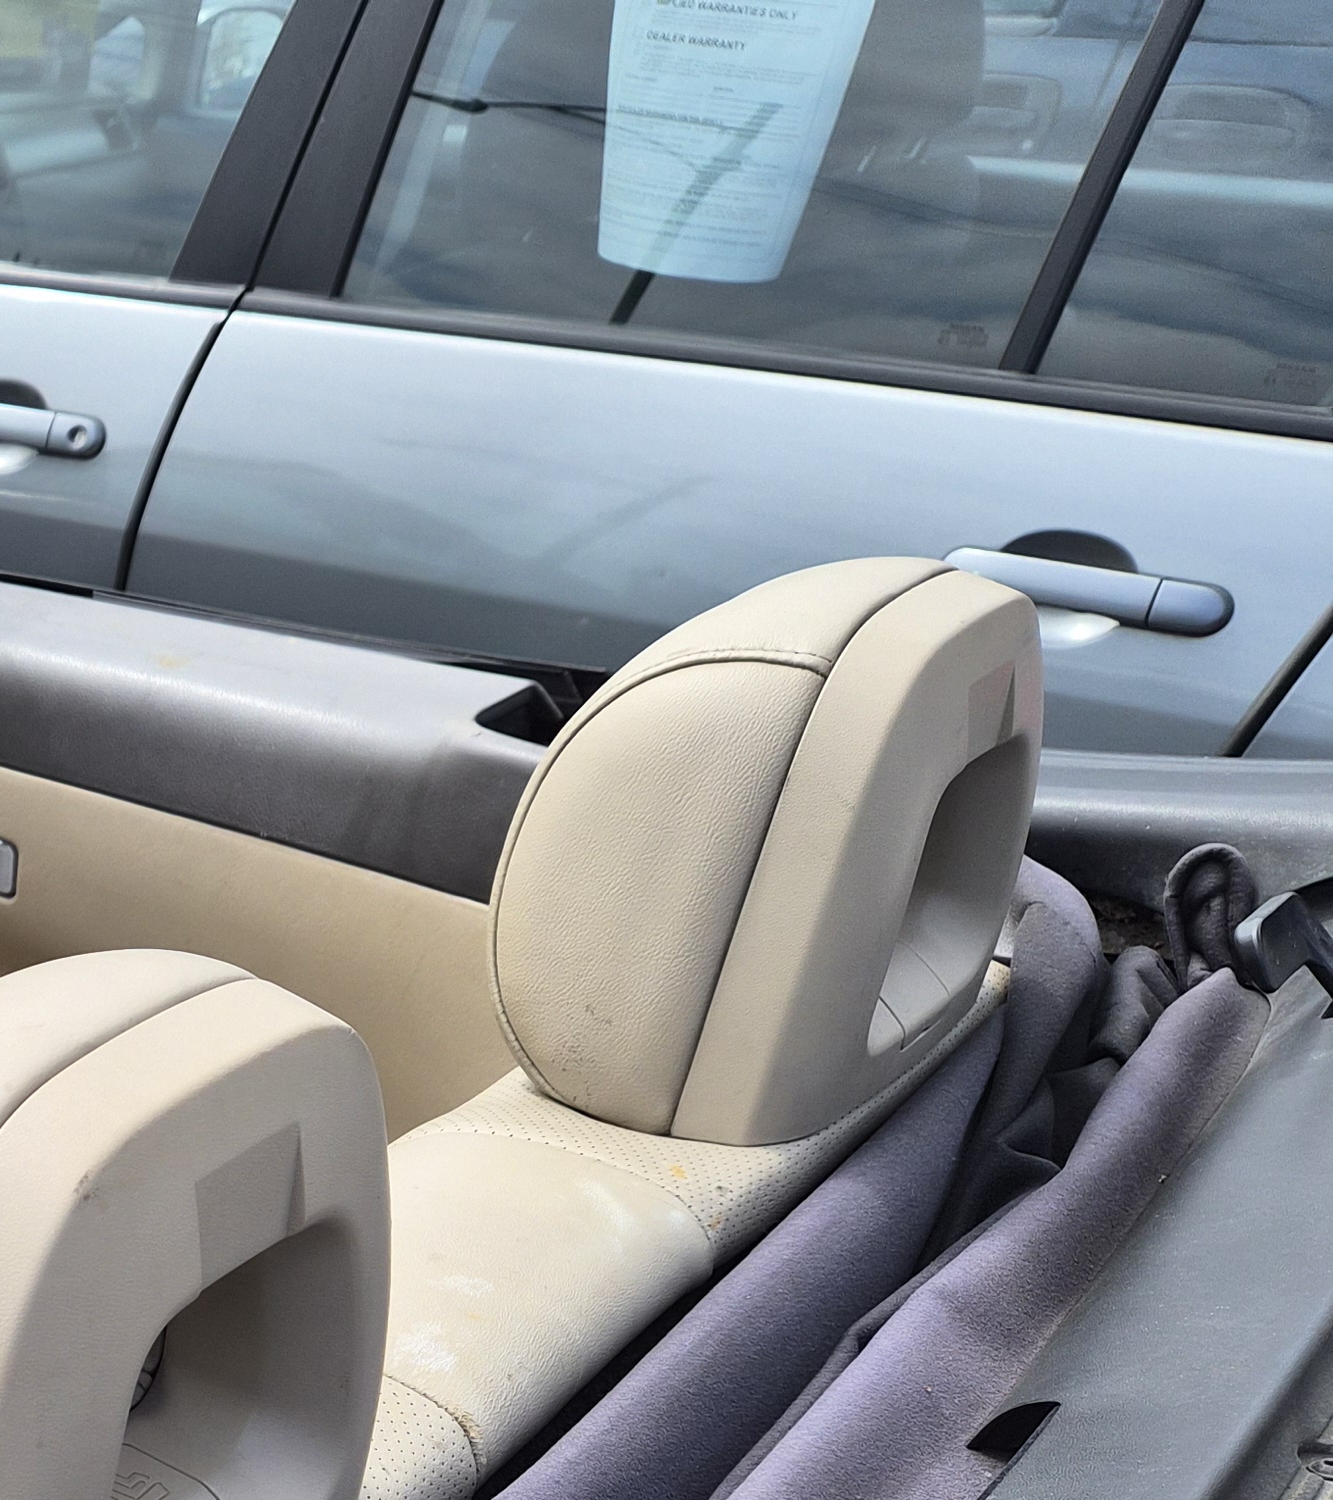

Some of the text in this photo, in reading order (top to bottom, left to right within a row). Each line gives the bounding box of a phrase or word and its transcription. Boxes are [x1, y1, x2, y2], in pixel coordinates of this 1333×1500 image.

[697, 1, 767, 18] WARRANTIES
[768, 9, 798, 20] ONLY
[646, 30, 746, 51] DEALER WARRANTY
